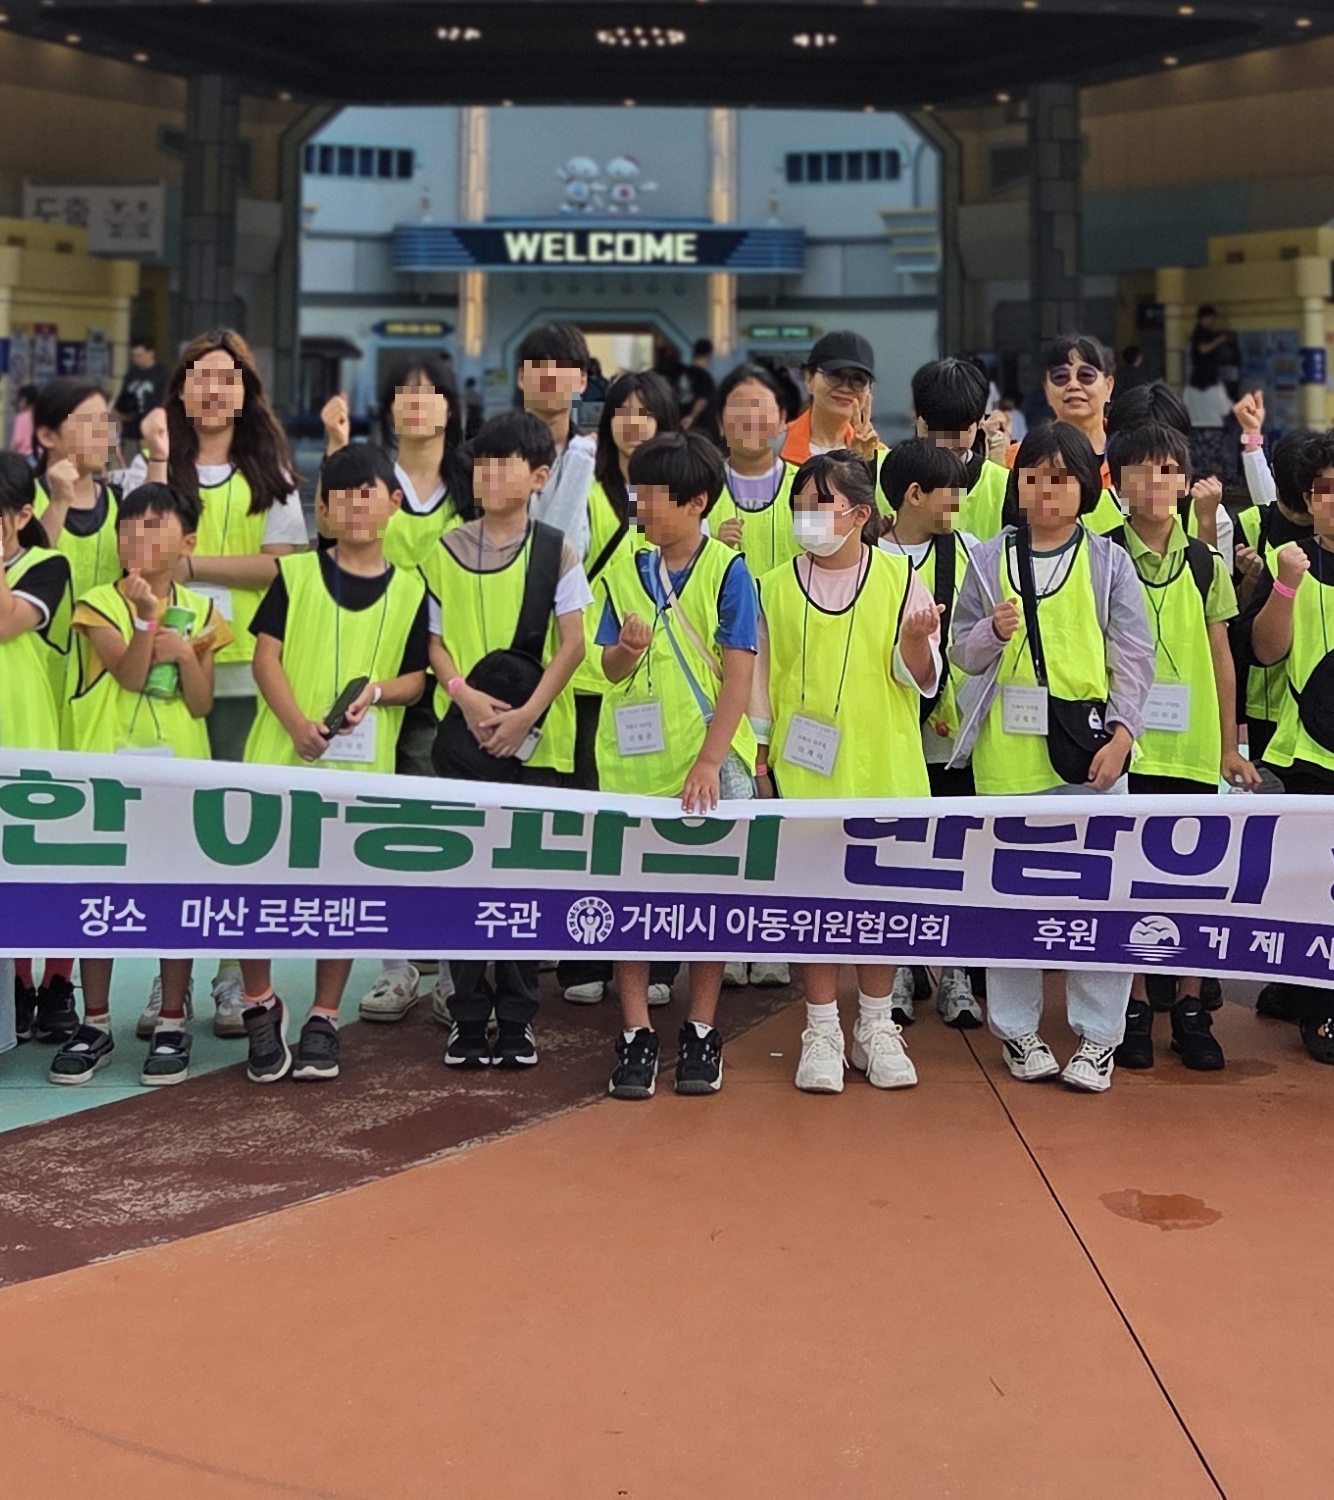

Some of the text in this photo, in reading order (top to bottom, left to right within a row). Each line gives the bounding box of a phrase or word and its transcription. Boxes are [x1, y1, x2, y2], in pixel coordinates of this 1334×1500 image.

[504, 232, 698, 263] WELCOME
[79, 895, 147, 937] 장소
[181, 895, 250, 937] 마산
[254, 897, 389, 937] 로봇랜드
[474, 900, 542, 938] 주관
[620, 903, 717, 941] 거제시
[726, 906, 951, 947] 아동위원협의회
[1033, 917, 1098, 952] 후원
